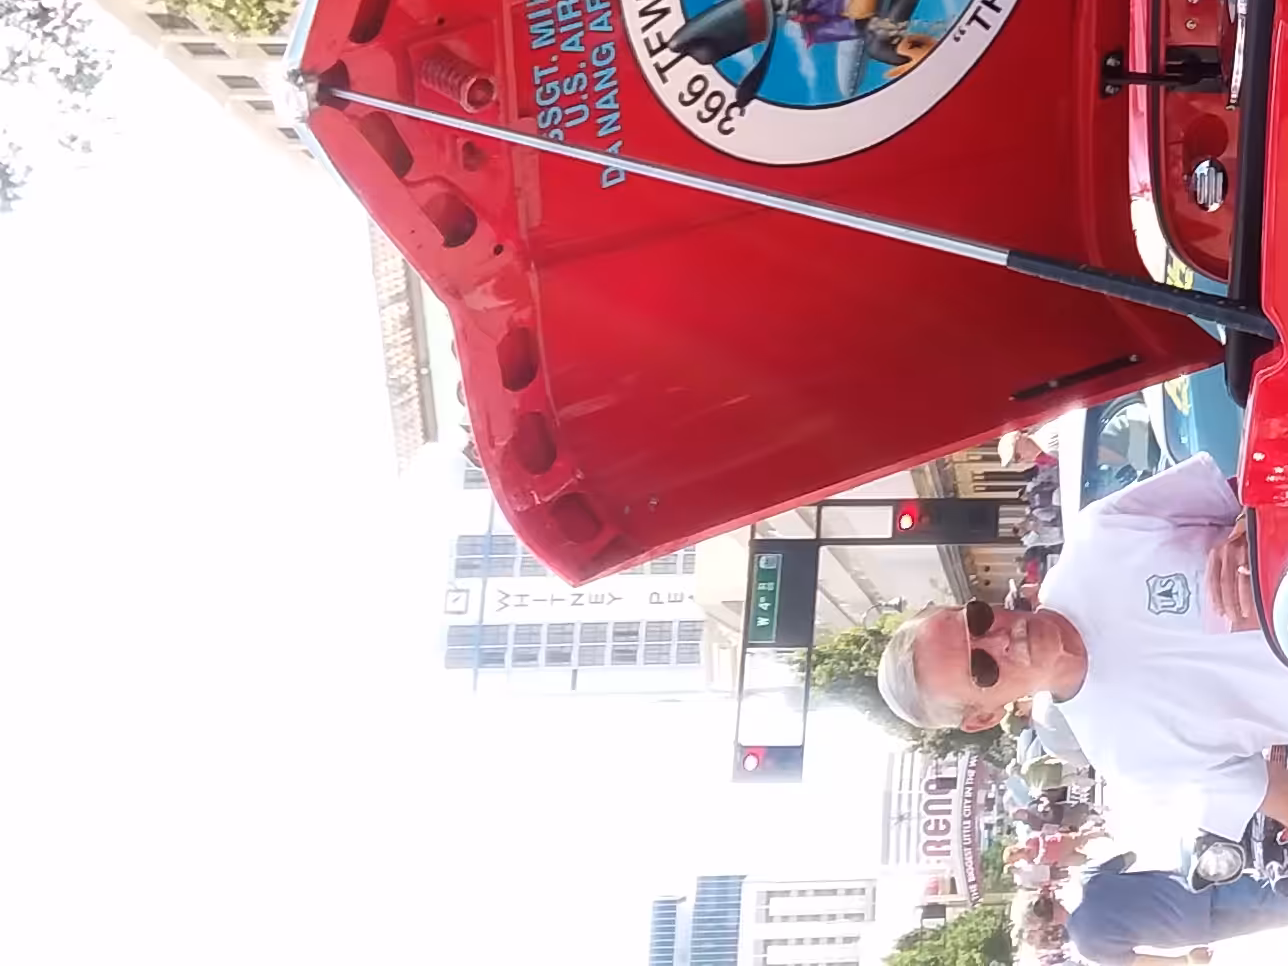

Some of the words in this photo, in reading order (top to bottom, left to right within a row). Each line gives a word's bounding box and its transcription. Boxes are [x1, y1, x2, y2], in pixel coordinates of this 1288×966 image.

[562, 61, 590, 128] U.S.
[591, 40, 622, 137] NANG
[677, 73, 746, 136] 366
[495, 589, 624, 612] WHITNEY
[756, 616, 771, 627] W
[965, 769, 977, 785] THE
[964, 787, 973, 797] IN
[921, 778, 953, 857] RENO
[963, 798, 973, 817] CITY
[962, 819, 972, 845] LITTLE
[963, 846, 976, 882] BIGGEST
[968, 884, 980, 901] THE
